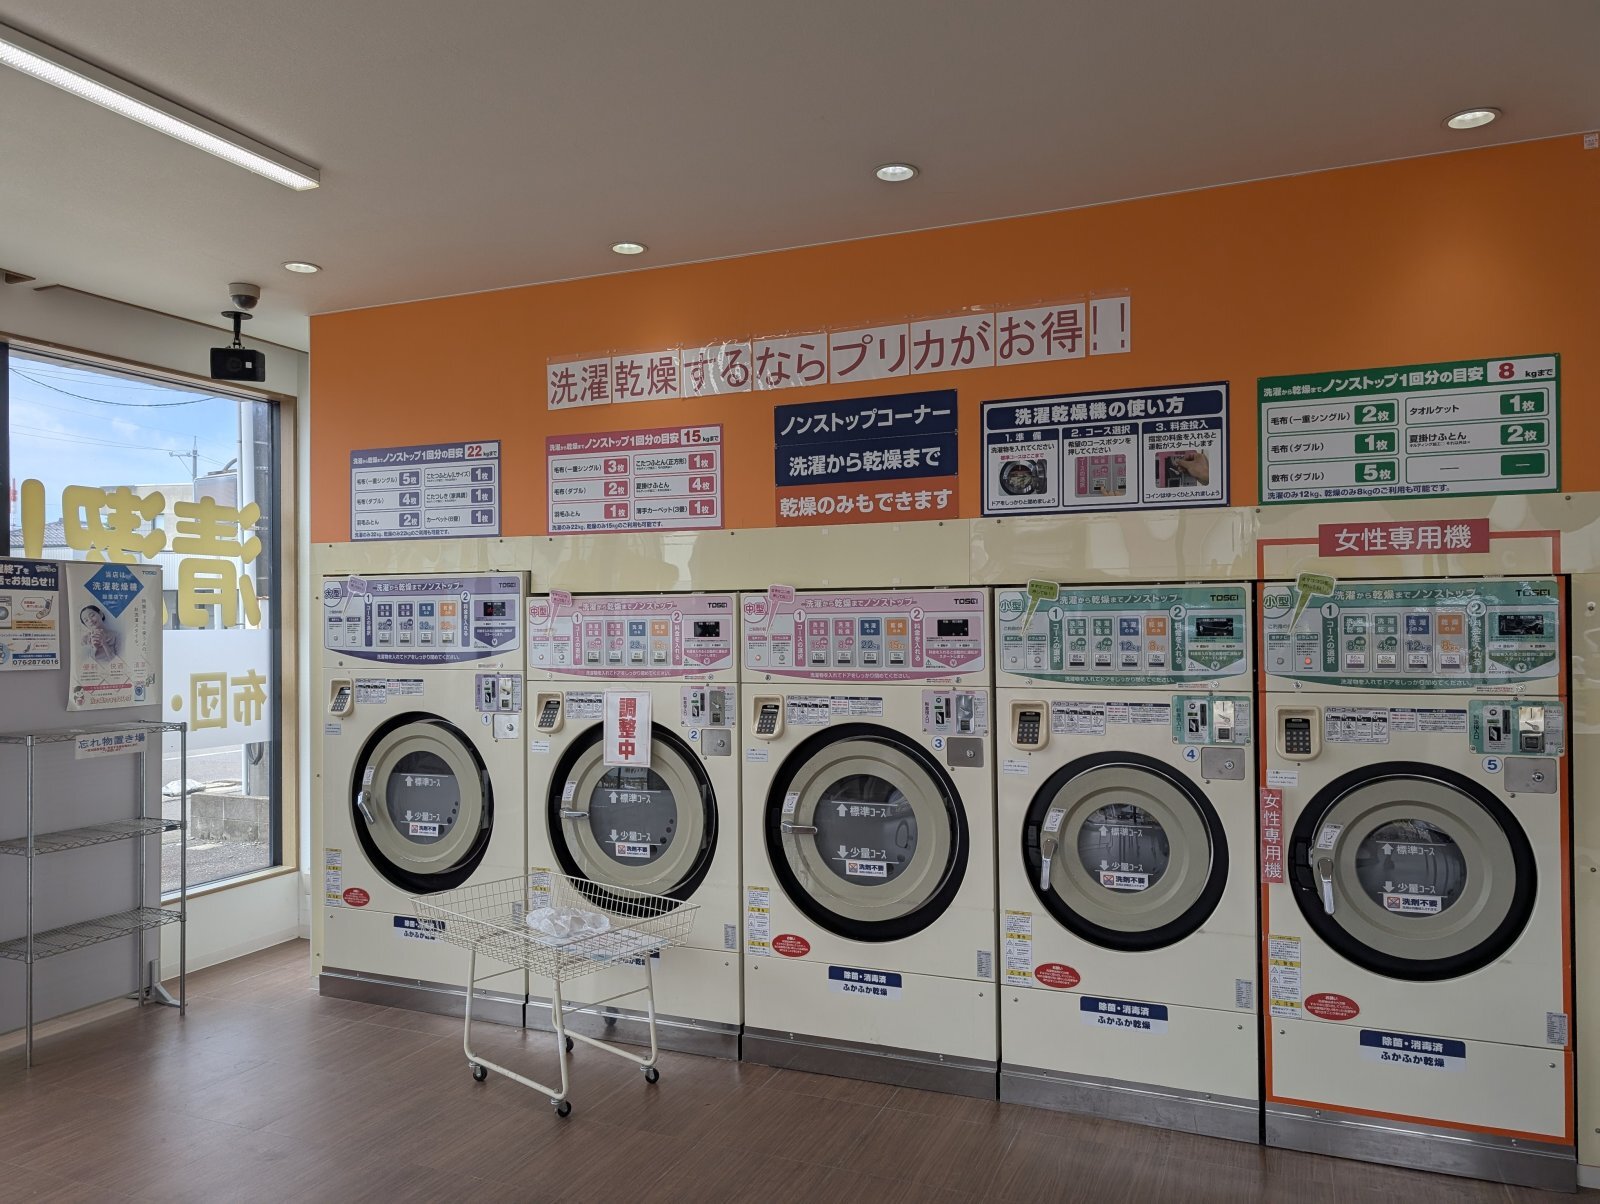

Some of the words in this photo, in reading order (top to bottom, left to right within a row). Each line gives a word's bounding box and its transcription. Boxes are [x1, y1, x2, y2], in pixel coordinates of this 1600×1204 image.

[1498, 362, 1515, 379] 8
[1409, 404, 1460, 416] タオルケット
[1509, 395, 1536, 413] 1枚
[1014, 396, 1185, 425] 洗濯乾燥機の使い方
[1361, 405, 1390, 422] 2枚
[780, 406, 951, 436] ノンストップコーナー
[1270, 412, 1351, 426] 毛布(一重シングル)
[1148, 432, 1217, 442] 指定の料金を入れると
[1409, 432, 1467, 444] 夏掛けふとん
[1506, 425, 1538, 442] 2枚
[991, 443, 1055, 454] 洗濯物を入れてください
[1068, 437, 1131, 448] 希望のコースボタンを
[1148, 440, 1213, 450] 運転がスタートします
[1270, 442, 1325, 454] 毛布(ダブル)
[1364, 434, 1389, 451] 1枚
[1068, 446, 1111, 456] 押してください
[607, 459, 625, 473] 3枚
[693, 455, 709, 468] 1枚
[789, 446, 942, 476] 洗濯から乾燥まで
[475, 468, 489, 481] 1枚
[1270, 471, 1325, 483] 敷布(ダブル)
[1362, 464, 1392, 481] 5枚
[608, 482, 625, 495] 2枚
[635, 482, 670, 490] 夏掛けふとん
[691, 477, 710, 491] 4枚
[475, 490, 489, 502] 1枚
[693, 501, 710, 514] 1枚
[780, 489, 952, 518] 乾燥のみもできます
[475, 511, 489, 523] 1枚
[609, 505, 626, 518] 1枚
[1335, 525, 1472, 552] 女性専用機
[92, 581, 138, 592] 洗濯乾燥機
[366, 593, 371, 602] 1
[463, 592, 468, 601] 2
[1000, 599, 1023, 612] 小型
[1059, 593, 1178, 605] 洗濯から乾燥までノンストップ
[1209, 594, 1239, 602] TOSEI
[1265, 595, 1291, 608] 小型
[1334, 588, 1476, 601] 洗濯から乾燥までノンストップ
[529, 605, 548, 617] 中型
[744, 603, 767, 616] 中型
[805, 597, 914, 608] 洗濯から乾燥までノンストップ
[1175, 607, 1182, 618] 2
[1326, 605, 1334, 617] 1
[1471, 602, 1481, 614] 2
[575, 614, 580, 623] 1
[674, 612, 680, 621] 2
[796, 610, 802, 620] 1
[913, 609, 920, 620] 2
[1053, 609, 1059, 620] 1
[1174, 622, 1182, 664] 料金を入れる
[1326, 622, 1335, 664] コースの選択
[484, 715, 489, 723] 1
[618, 697, 637, 761] 調整中
[690, 730, 698, 739] 2
[78, 732, 146, 750] 忘れ物置き場
[934, 738, 943, 748] 3
[1186, 749, 1196, 759] 4
[1487, 759, 1498, 770] 5
[620, 793, 651, 803] 標準コース
[849, 806, 887, 818] 標準コース
[620, 831, 651, 841] 少量コース
[1111, 827, 1143, 838] 標準コース
[1263, 793, 1283, 880] 女性専用機
[850, 847, 887, 859] 少量コース
[1397, 844, 1435, 856] 標準コース
[1112, 861, 1144, 872] 少量コース
[1115, 875, 1146, 884] 洗剤不要
[1397, 882, 1436, 894] 少量コース
[1402, 897, 1438, 908] 洗剤不要
[842, 983, 888, 996] ふかふか乾燥
[1098, 1002, 1150, 1017] 除菌・消毒済
[1097, 1015, 1151, 1030] ふかふか乾燥
[1381, 1035, 1444, 1053] 除菌・消毒済
[1381, 1051, 1445, 1068] ふかふか乾燥
